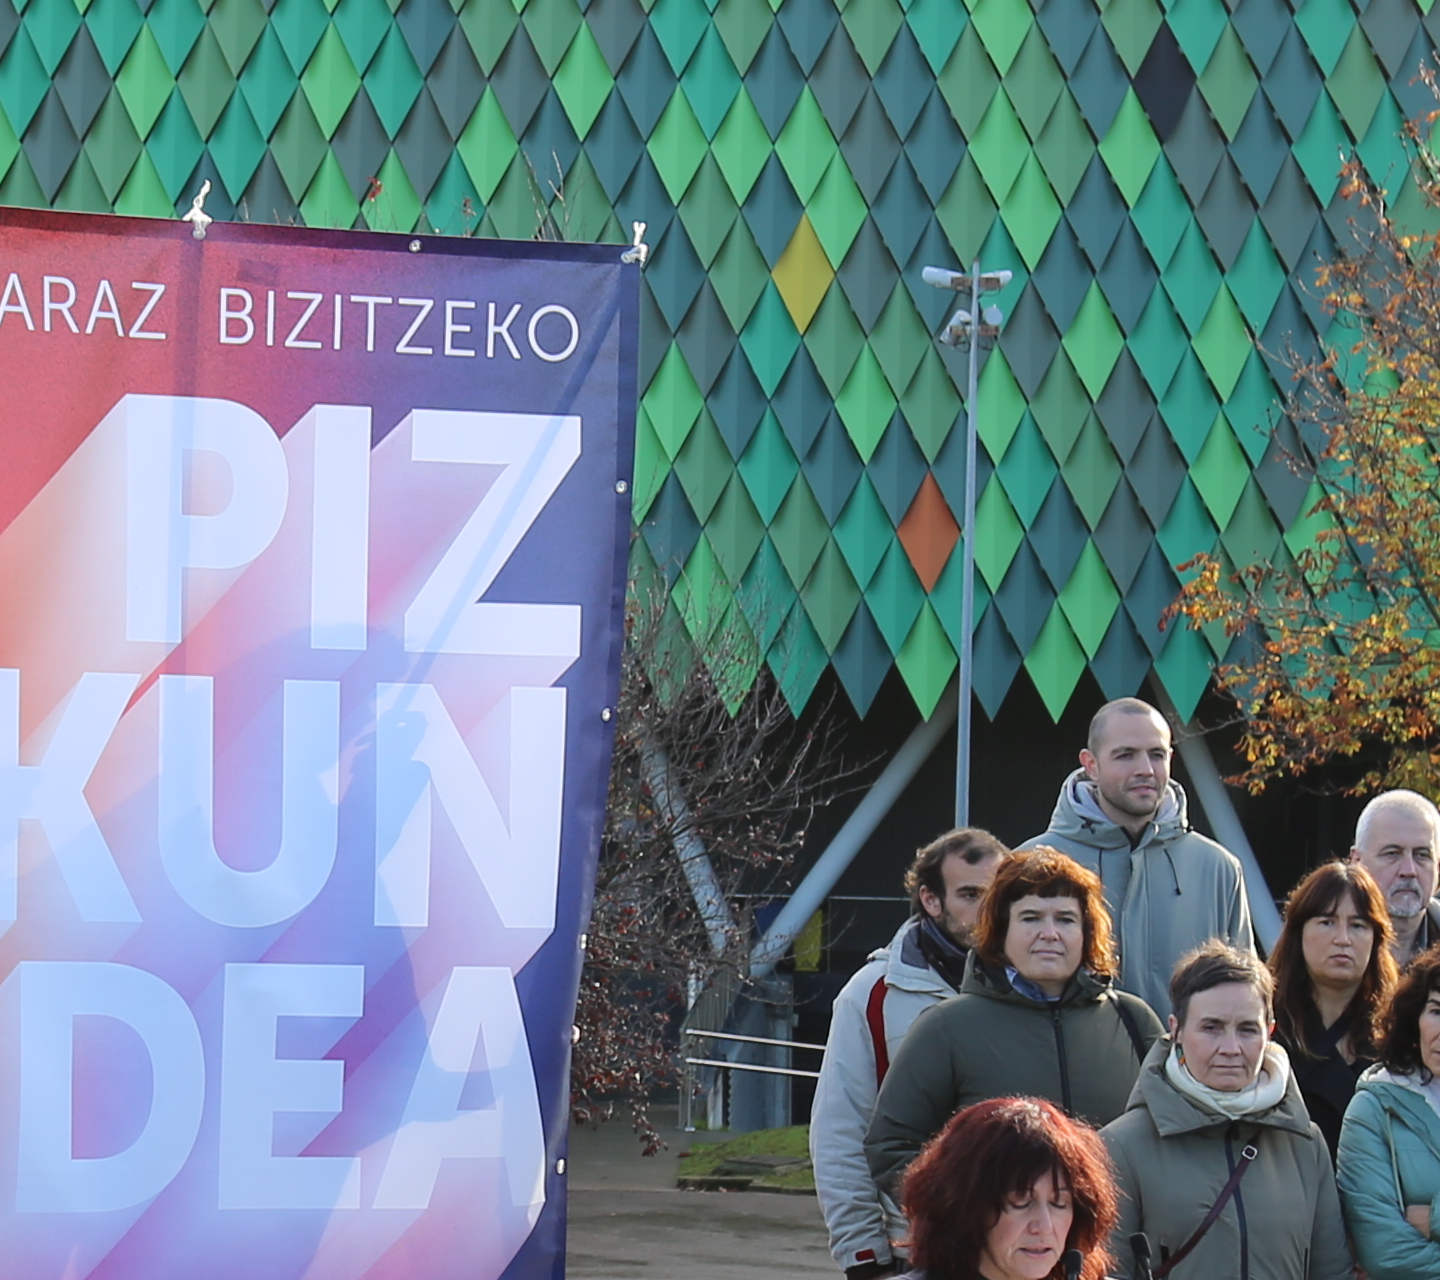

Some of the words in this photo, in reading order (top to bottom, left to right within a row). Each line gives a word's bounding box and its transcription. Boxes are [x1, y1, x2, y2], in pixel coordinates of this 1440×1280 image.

[218, 287, 580, 363] BIZITZEKO
[125, 393, 582, 658] PIZ
[16, 960, 547, 1214] DEA
